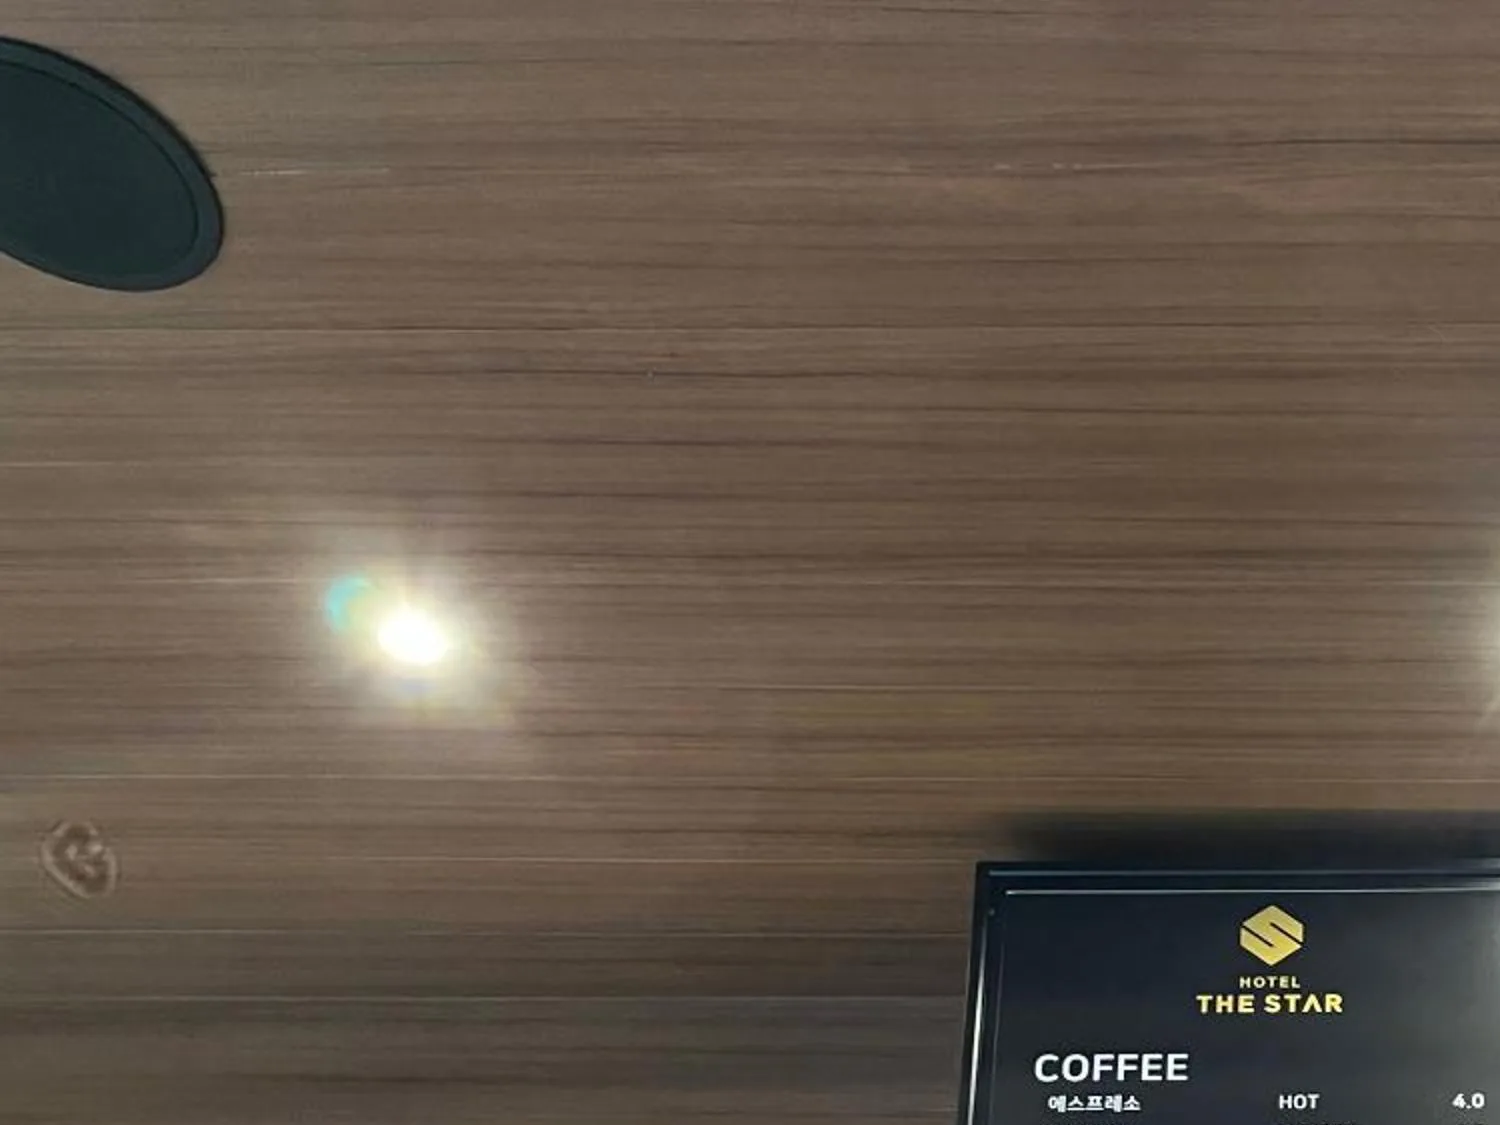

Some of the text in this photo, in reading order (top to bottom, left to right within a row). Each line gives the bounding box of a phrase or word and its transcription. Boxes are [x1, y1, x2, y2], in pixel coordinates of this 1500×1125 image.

[1239, 975, 1301, 989] HOTEL
[1195, 993, 1343, 1014] THE STAR
[1034, 1053, 1189, 1083] COFFEE
[1047, 1092, 1485, 1113] 에스프레소 HOT 4.0
